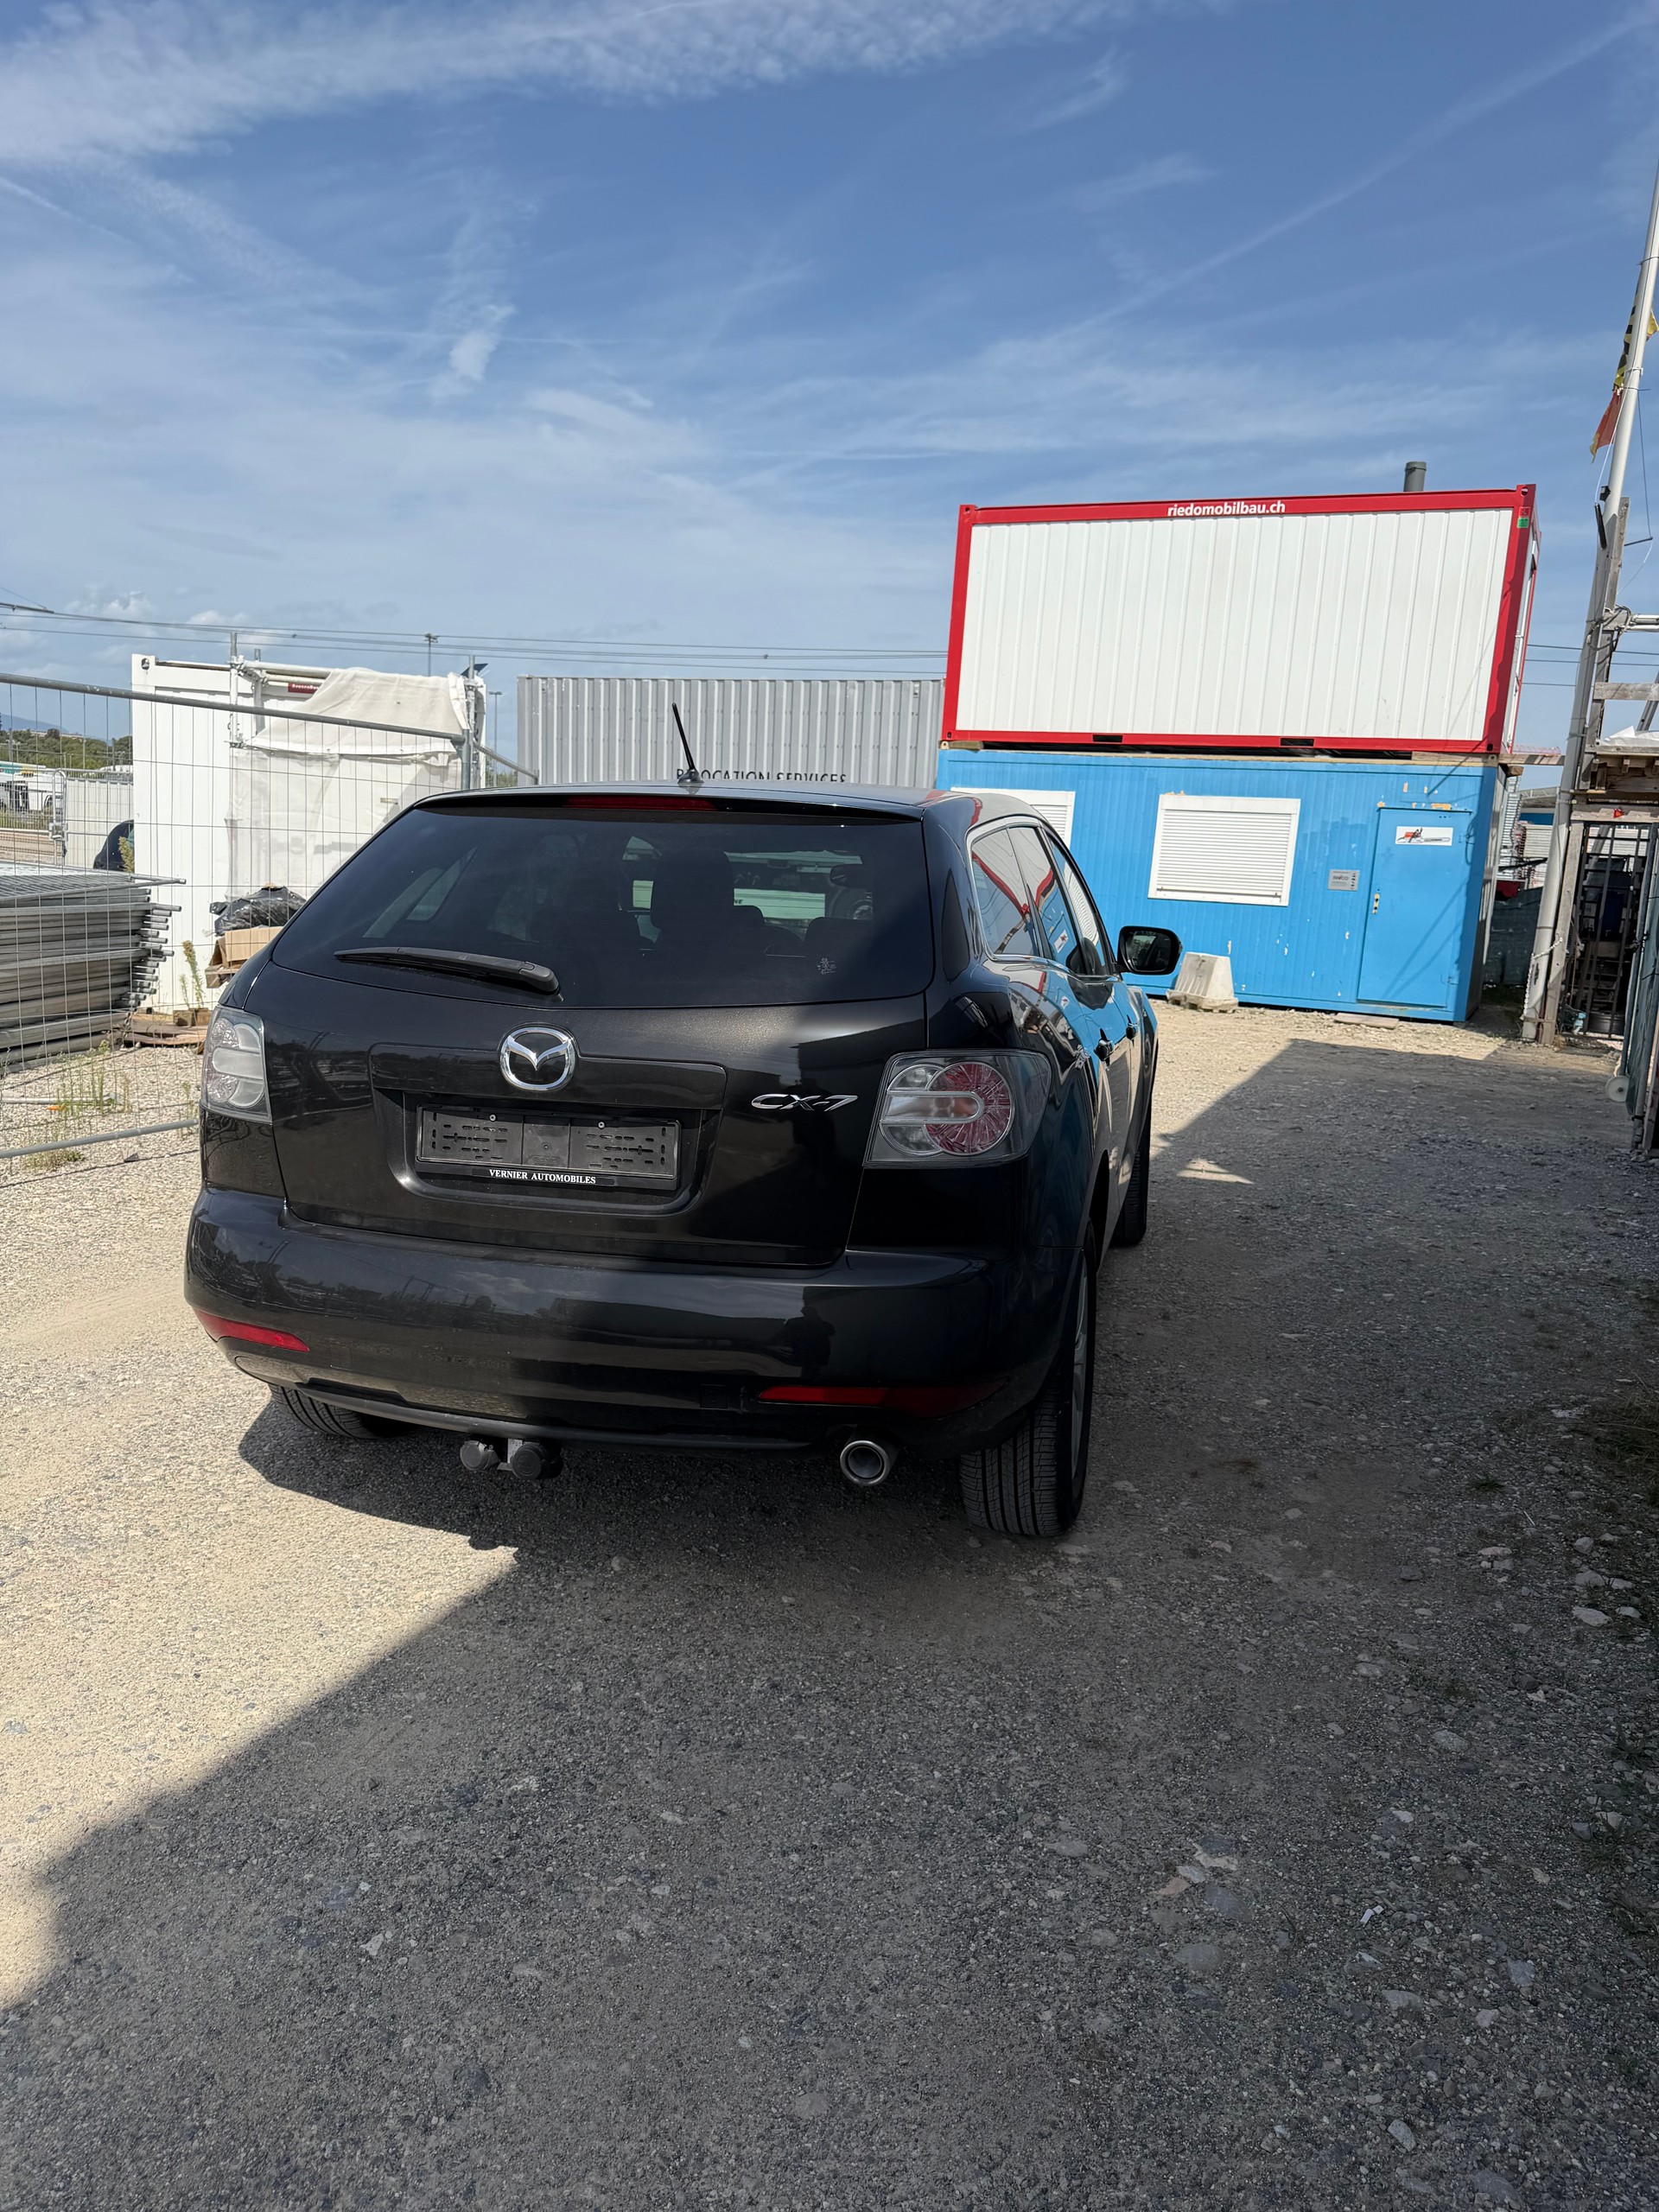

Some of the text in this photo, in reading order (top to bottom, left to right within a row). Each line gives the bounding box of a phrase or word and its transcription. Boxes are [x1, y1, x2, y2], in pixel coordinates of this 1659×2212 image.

[1167, 500, 1286, 517] riedomobilbau.ch
[677, 768, 770, 779] ROCATION
[751, 1093, 858, 1111] CX-7
[489, 1169, 596, 1184] VERNIER AUTOMOBILES
